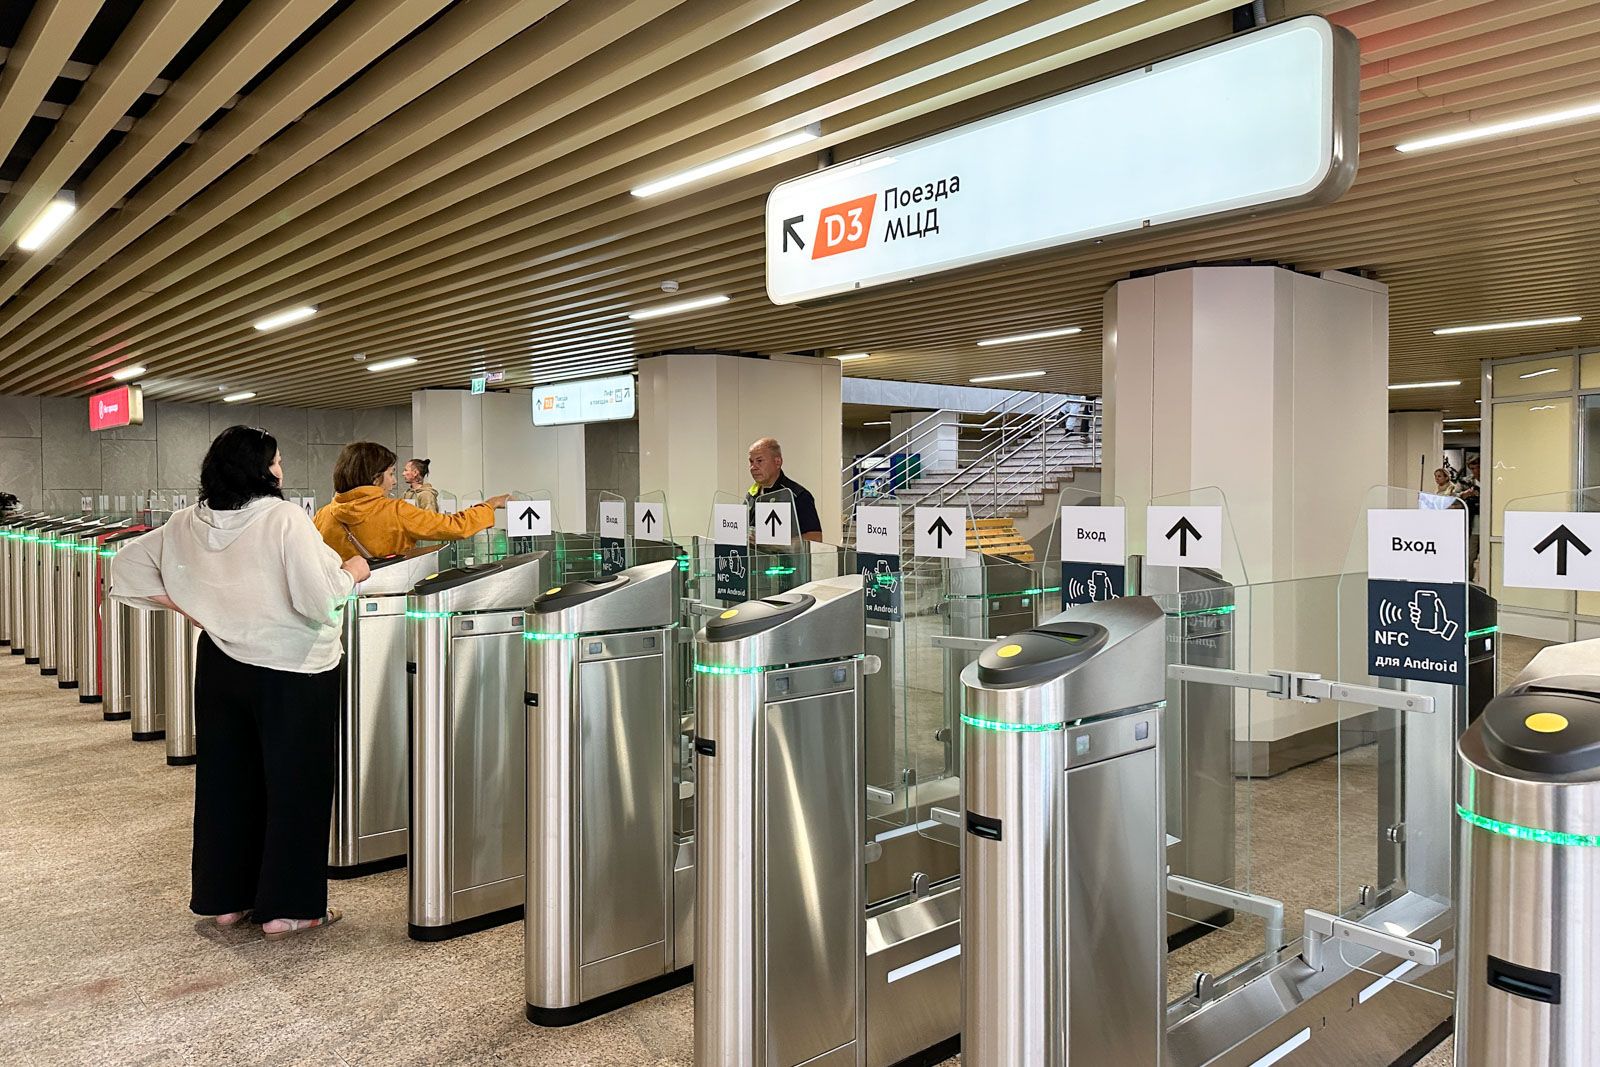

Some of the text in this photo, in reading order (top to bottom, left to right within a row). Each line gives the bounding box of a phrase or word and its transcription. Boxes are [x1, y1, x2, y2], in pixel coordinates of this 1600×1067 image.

[884, 175, 960, 211] Поезда
[824, 207, 863, 247] D3
[884, 208, 939, 242] МЦД
[606, 515, 618, 524] Вход
[722, 519, 738, 529] Вход
[867, 523, 887, 535] Вход
[1077, 528, 1106, 542] Вход
[1392, 537, 1437, 554] Вход
[717, 573, 730, 582] NFC
[727, 587, 746, 596] Android
[866, 588, 877, 598] FC
[873, 604, 898, 614] Android
[1375, 631, 1409, 647] NFC
[1375, 656, 1458, 674] для Android
